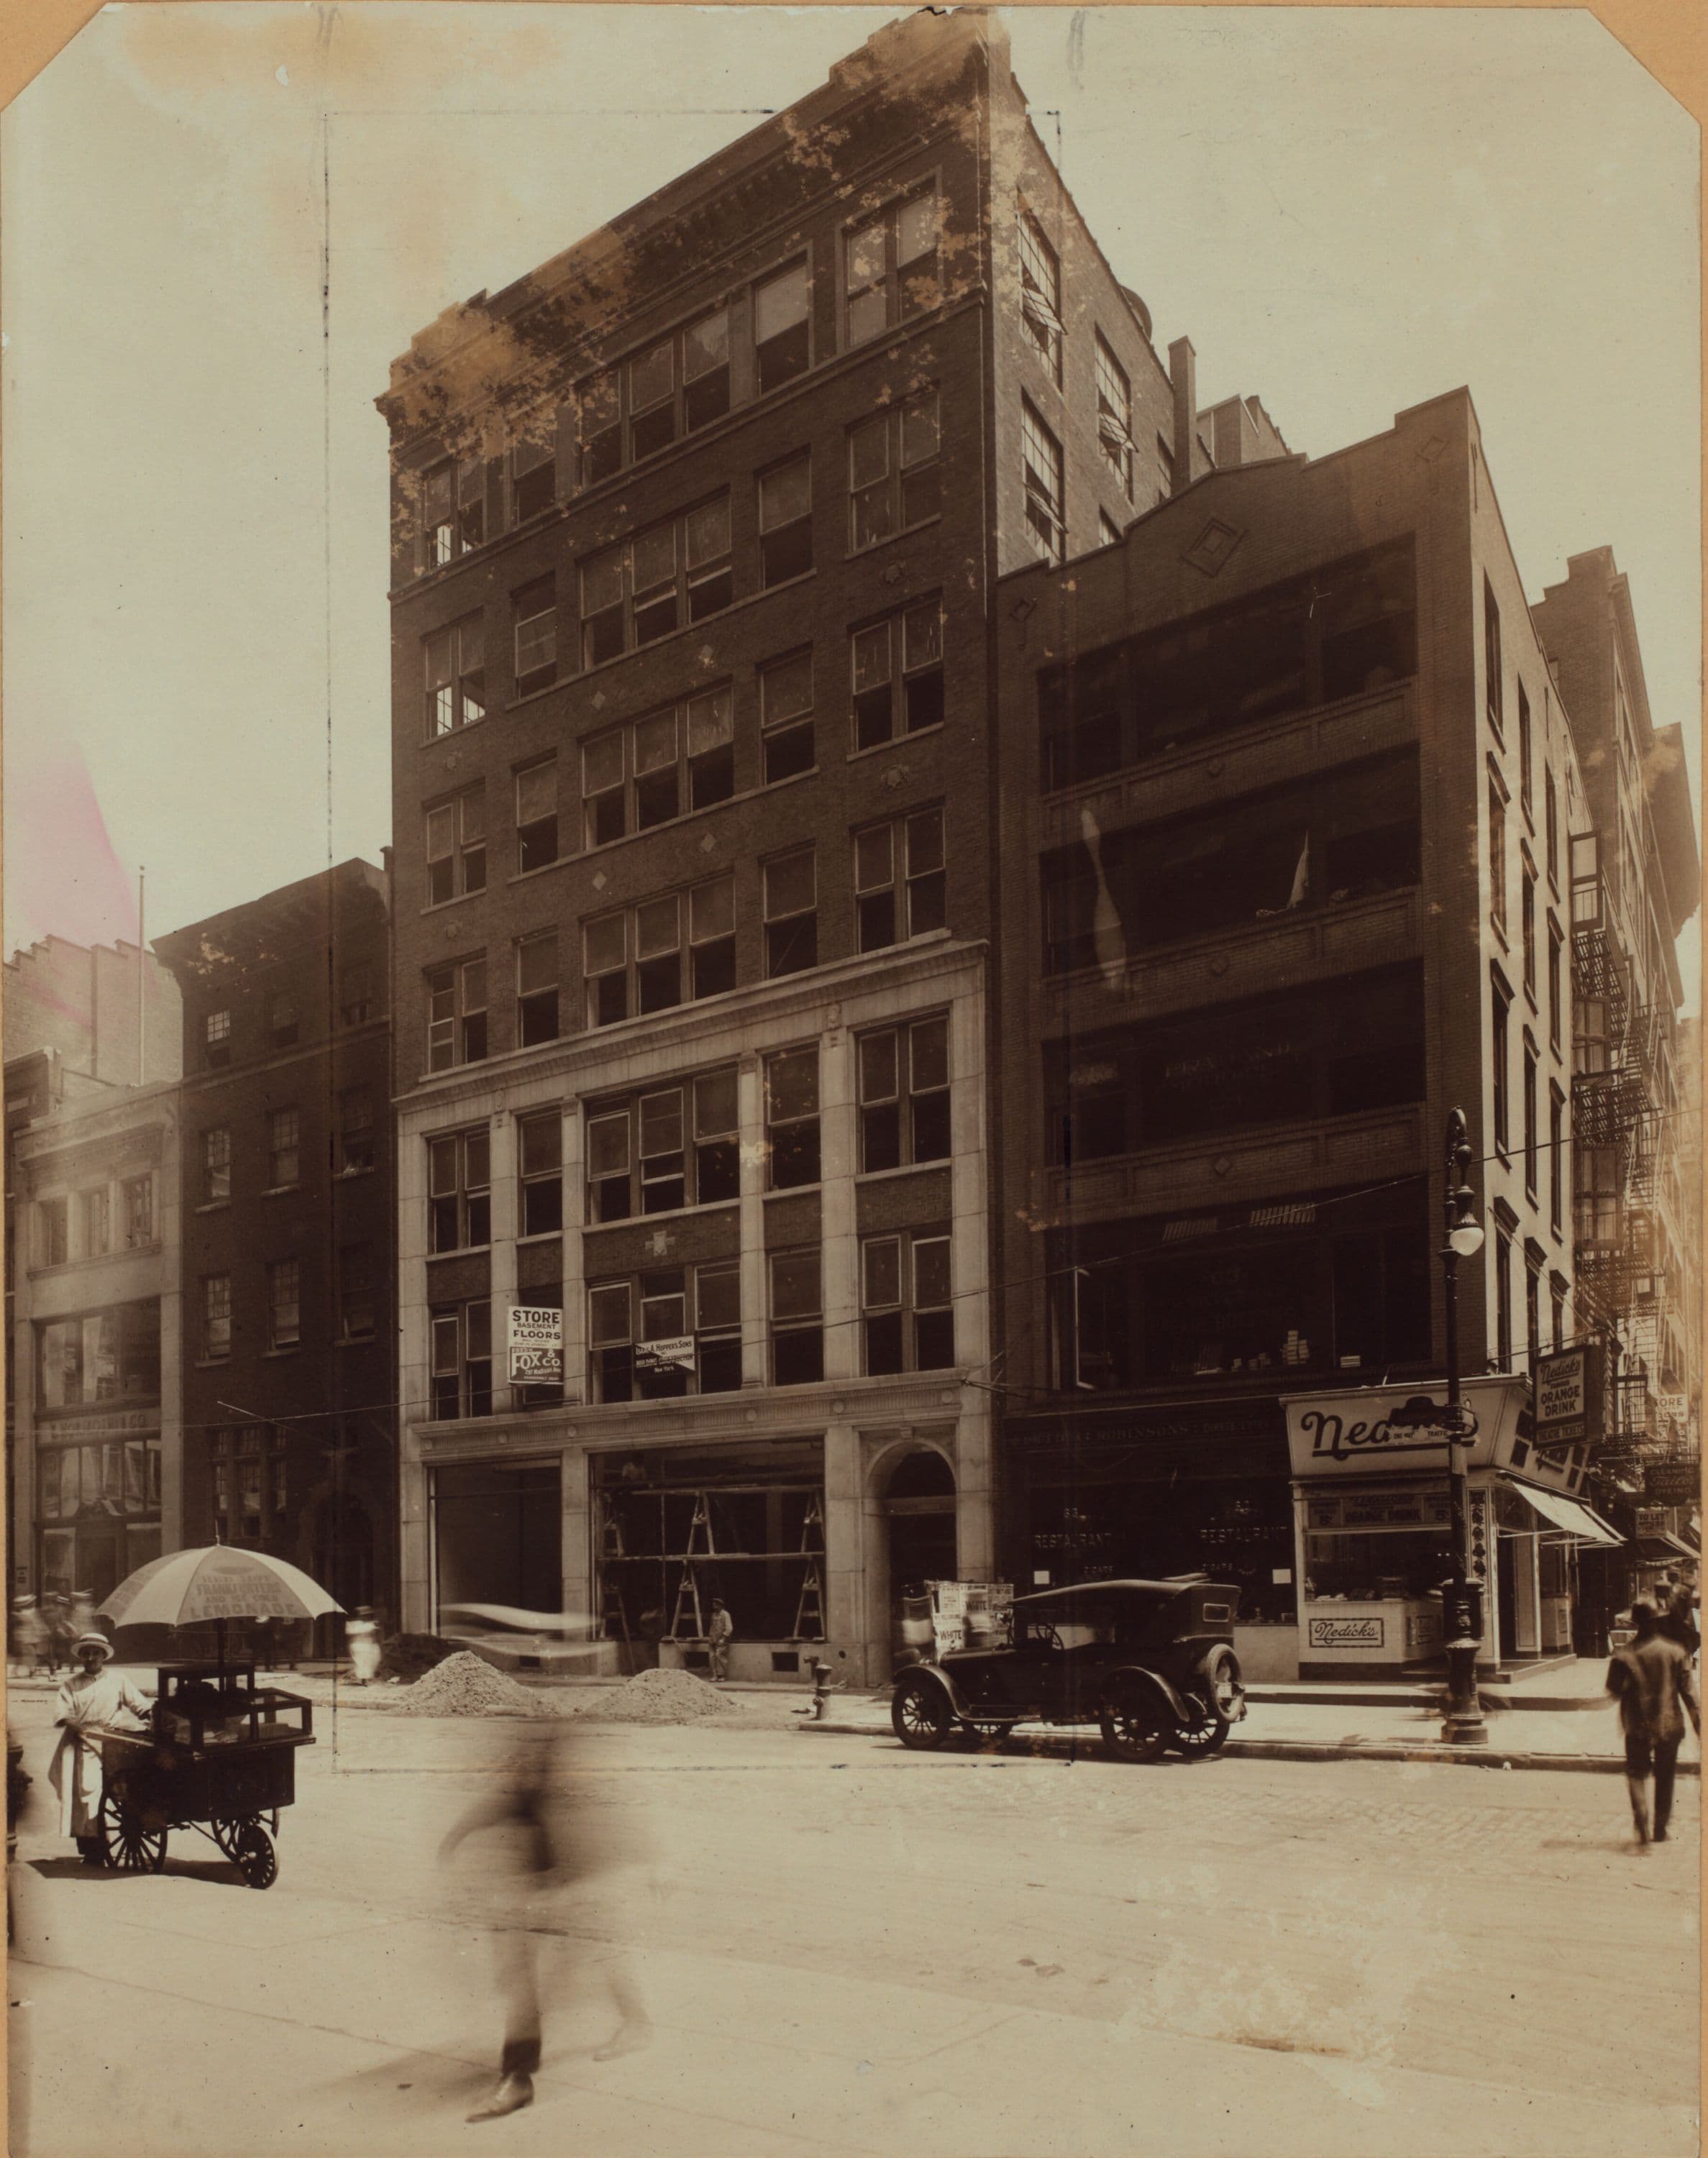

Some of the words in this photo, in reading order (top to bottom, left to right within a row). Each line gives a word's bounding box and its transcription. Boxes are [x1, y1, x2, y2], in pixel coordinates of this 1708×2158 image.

[513, 1309, 560, 1324] STORE
[513, 1330, 561, 1340] FLOORS
[511, 1350, 542, 1377] FOX
[1541, 1385, 1581, 1406] ORANGE
[1657, 1397, 1684, 1407] ORE
[1545, 1399, 1577, 1417] DRINK
[190, 1603, 298, 1619] LEMONADE
[1315, 1622, 1379, 1645] Nedick's
